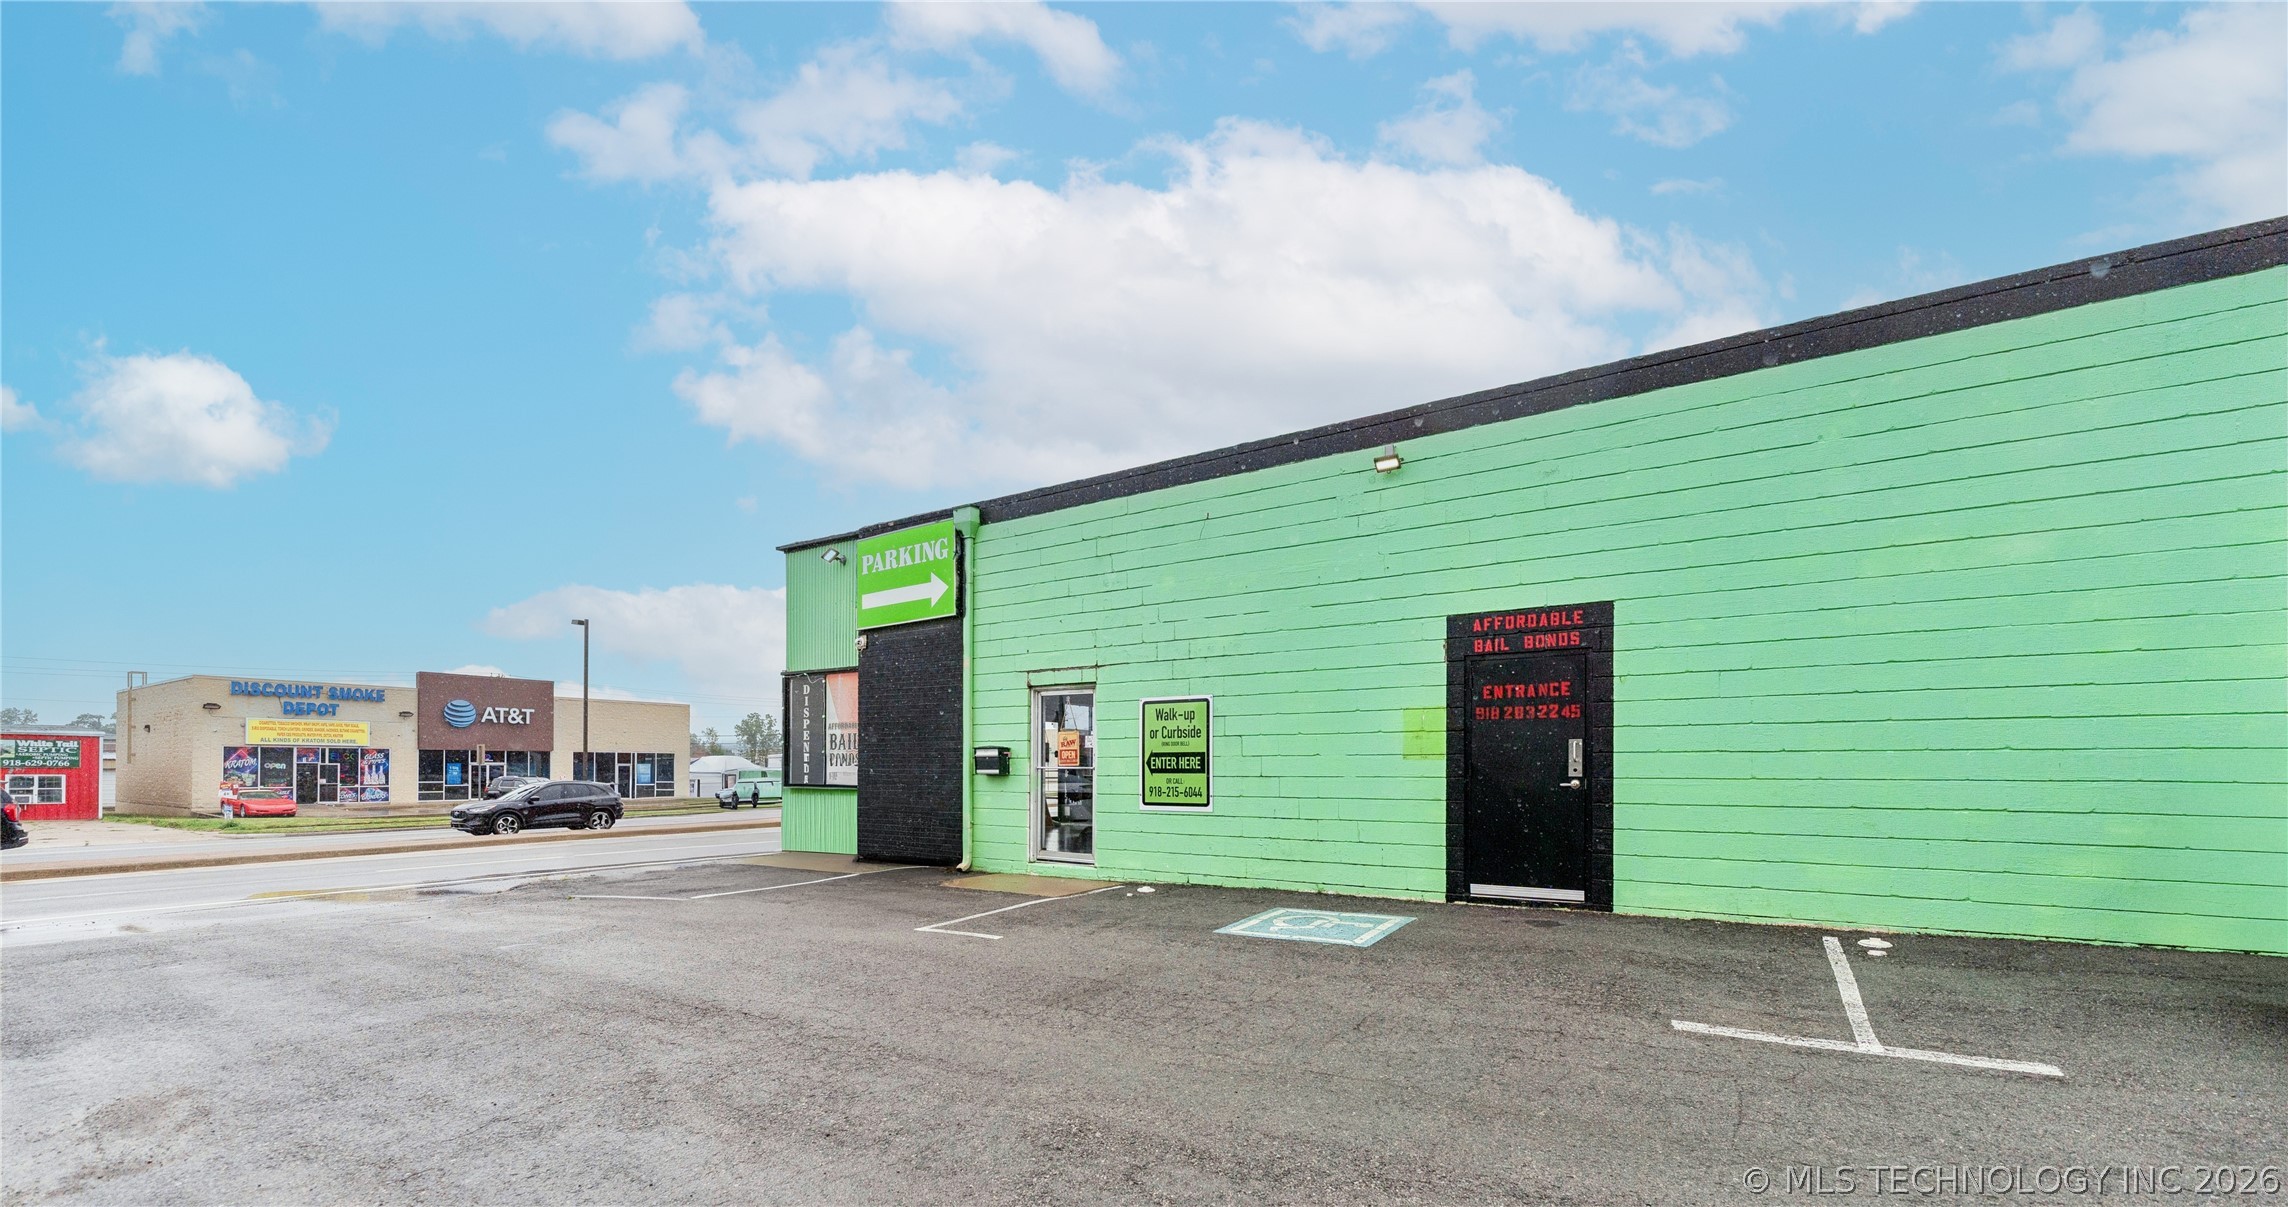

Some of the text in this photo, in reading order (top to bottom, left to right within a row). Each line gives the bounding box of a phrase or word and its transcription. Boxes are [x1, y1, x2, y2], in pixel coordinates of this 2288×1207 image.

[861, 537, 949, 575] PARKING
[1472, 610, 1584, 632] AFFORDABLE
[1474, 631, 1580, 653] BAIL BONDS
[230, 680, 386, 703] DISCOUNT SMOKE
[1482, 681, 1571, 699] ENTRANCE
[282, 701, 340, 717] DEPOT
[481, 706, 535, 725] AT&T
[1155, 708, 1195, 723] Walk-up
[1475, 706, 1500, 720] 918
[1149, 725, 1202, 739] or Curbside
[56, 740, 79, 748] Tail
[1060, 739, 1077, 748] RAW
[364, 752, 385, 760] GLASS
[1061, 750, 1076, 759] OPEN
[1150, 756, 1201, 770] ENTER HERE
[1149, 786, 1203, 798] 918-215-6044
